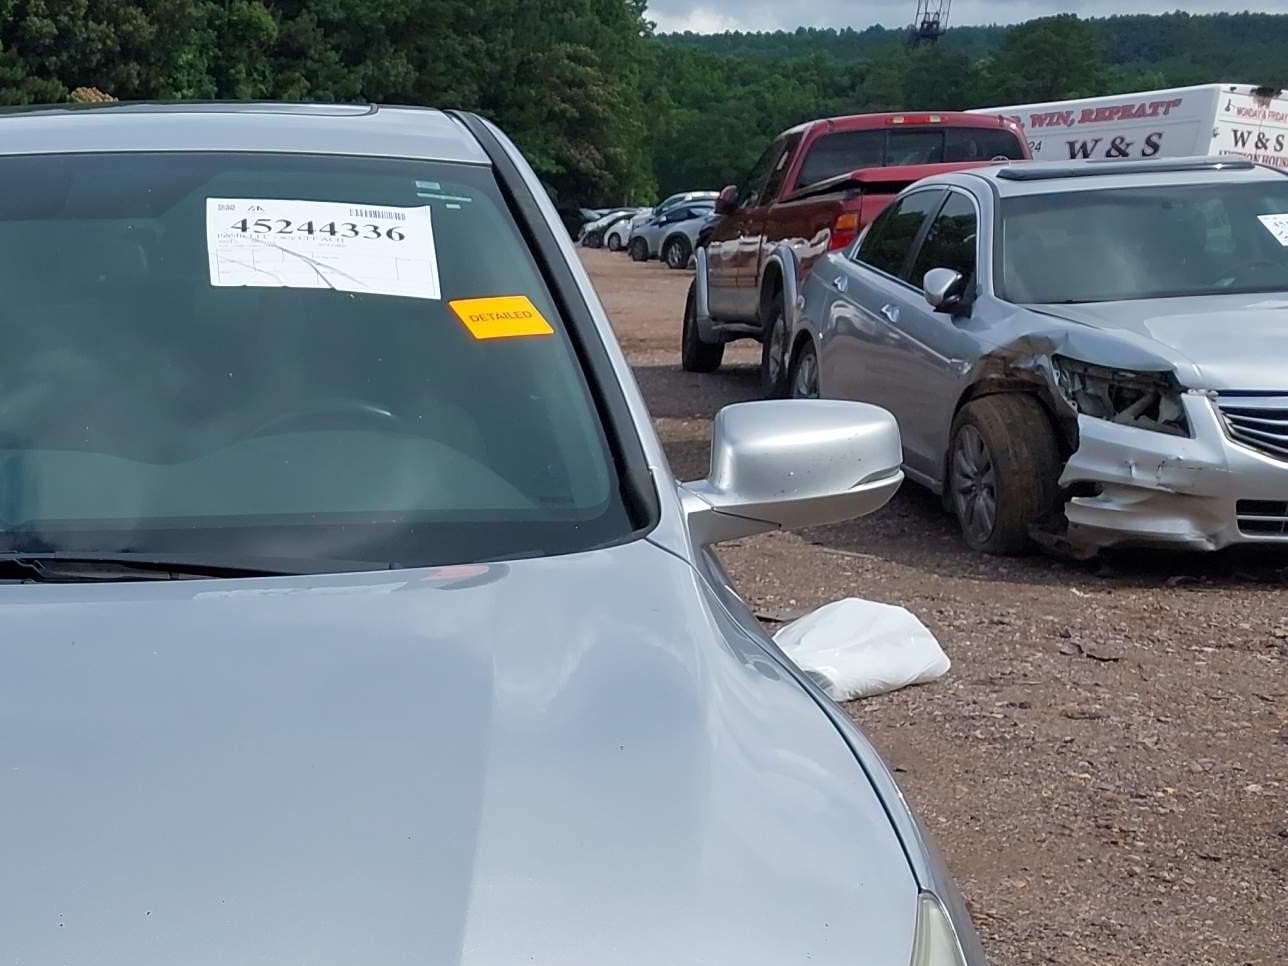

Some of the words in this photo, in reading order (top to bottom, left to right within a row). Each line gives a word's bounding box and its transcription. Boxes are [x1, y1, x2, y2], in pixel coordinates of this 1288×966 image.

[1030, 110, 1075, 128] WIN,
[1066, 138, 1102, 160] W
[1105, 136, 1133, 158] &
[1142, 132, 1164, 157] S
[1232, 129, 1253, 149] W
[1255, 132, 1270, 150] &
[1274, 134, 1285, 152] S
[230, 218, 406, 242] 45244336
[469, 310, 533, 323] DETAILED
